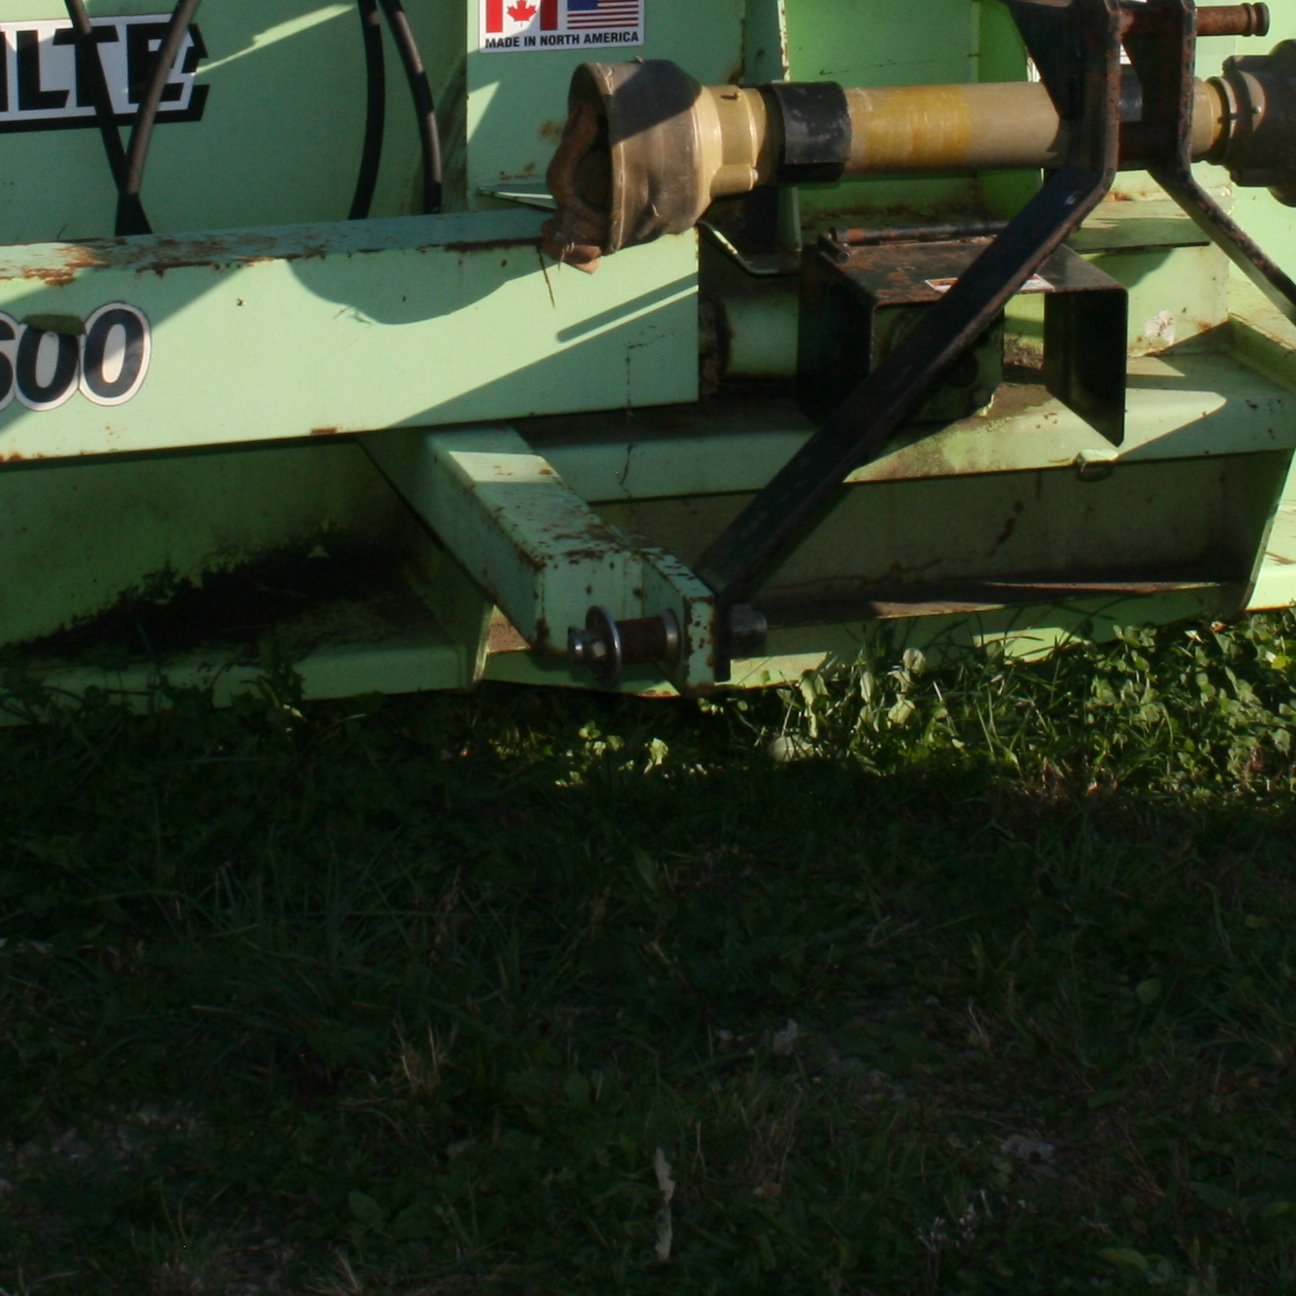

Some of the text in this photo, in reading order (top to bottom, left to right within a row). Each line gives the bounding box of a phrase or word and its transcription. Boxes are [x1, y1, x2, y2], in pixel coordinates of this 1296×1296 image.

[485, 31, 639, 49] MADE IN NORTH AMERICA
